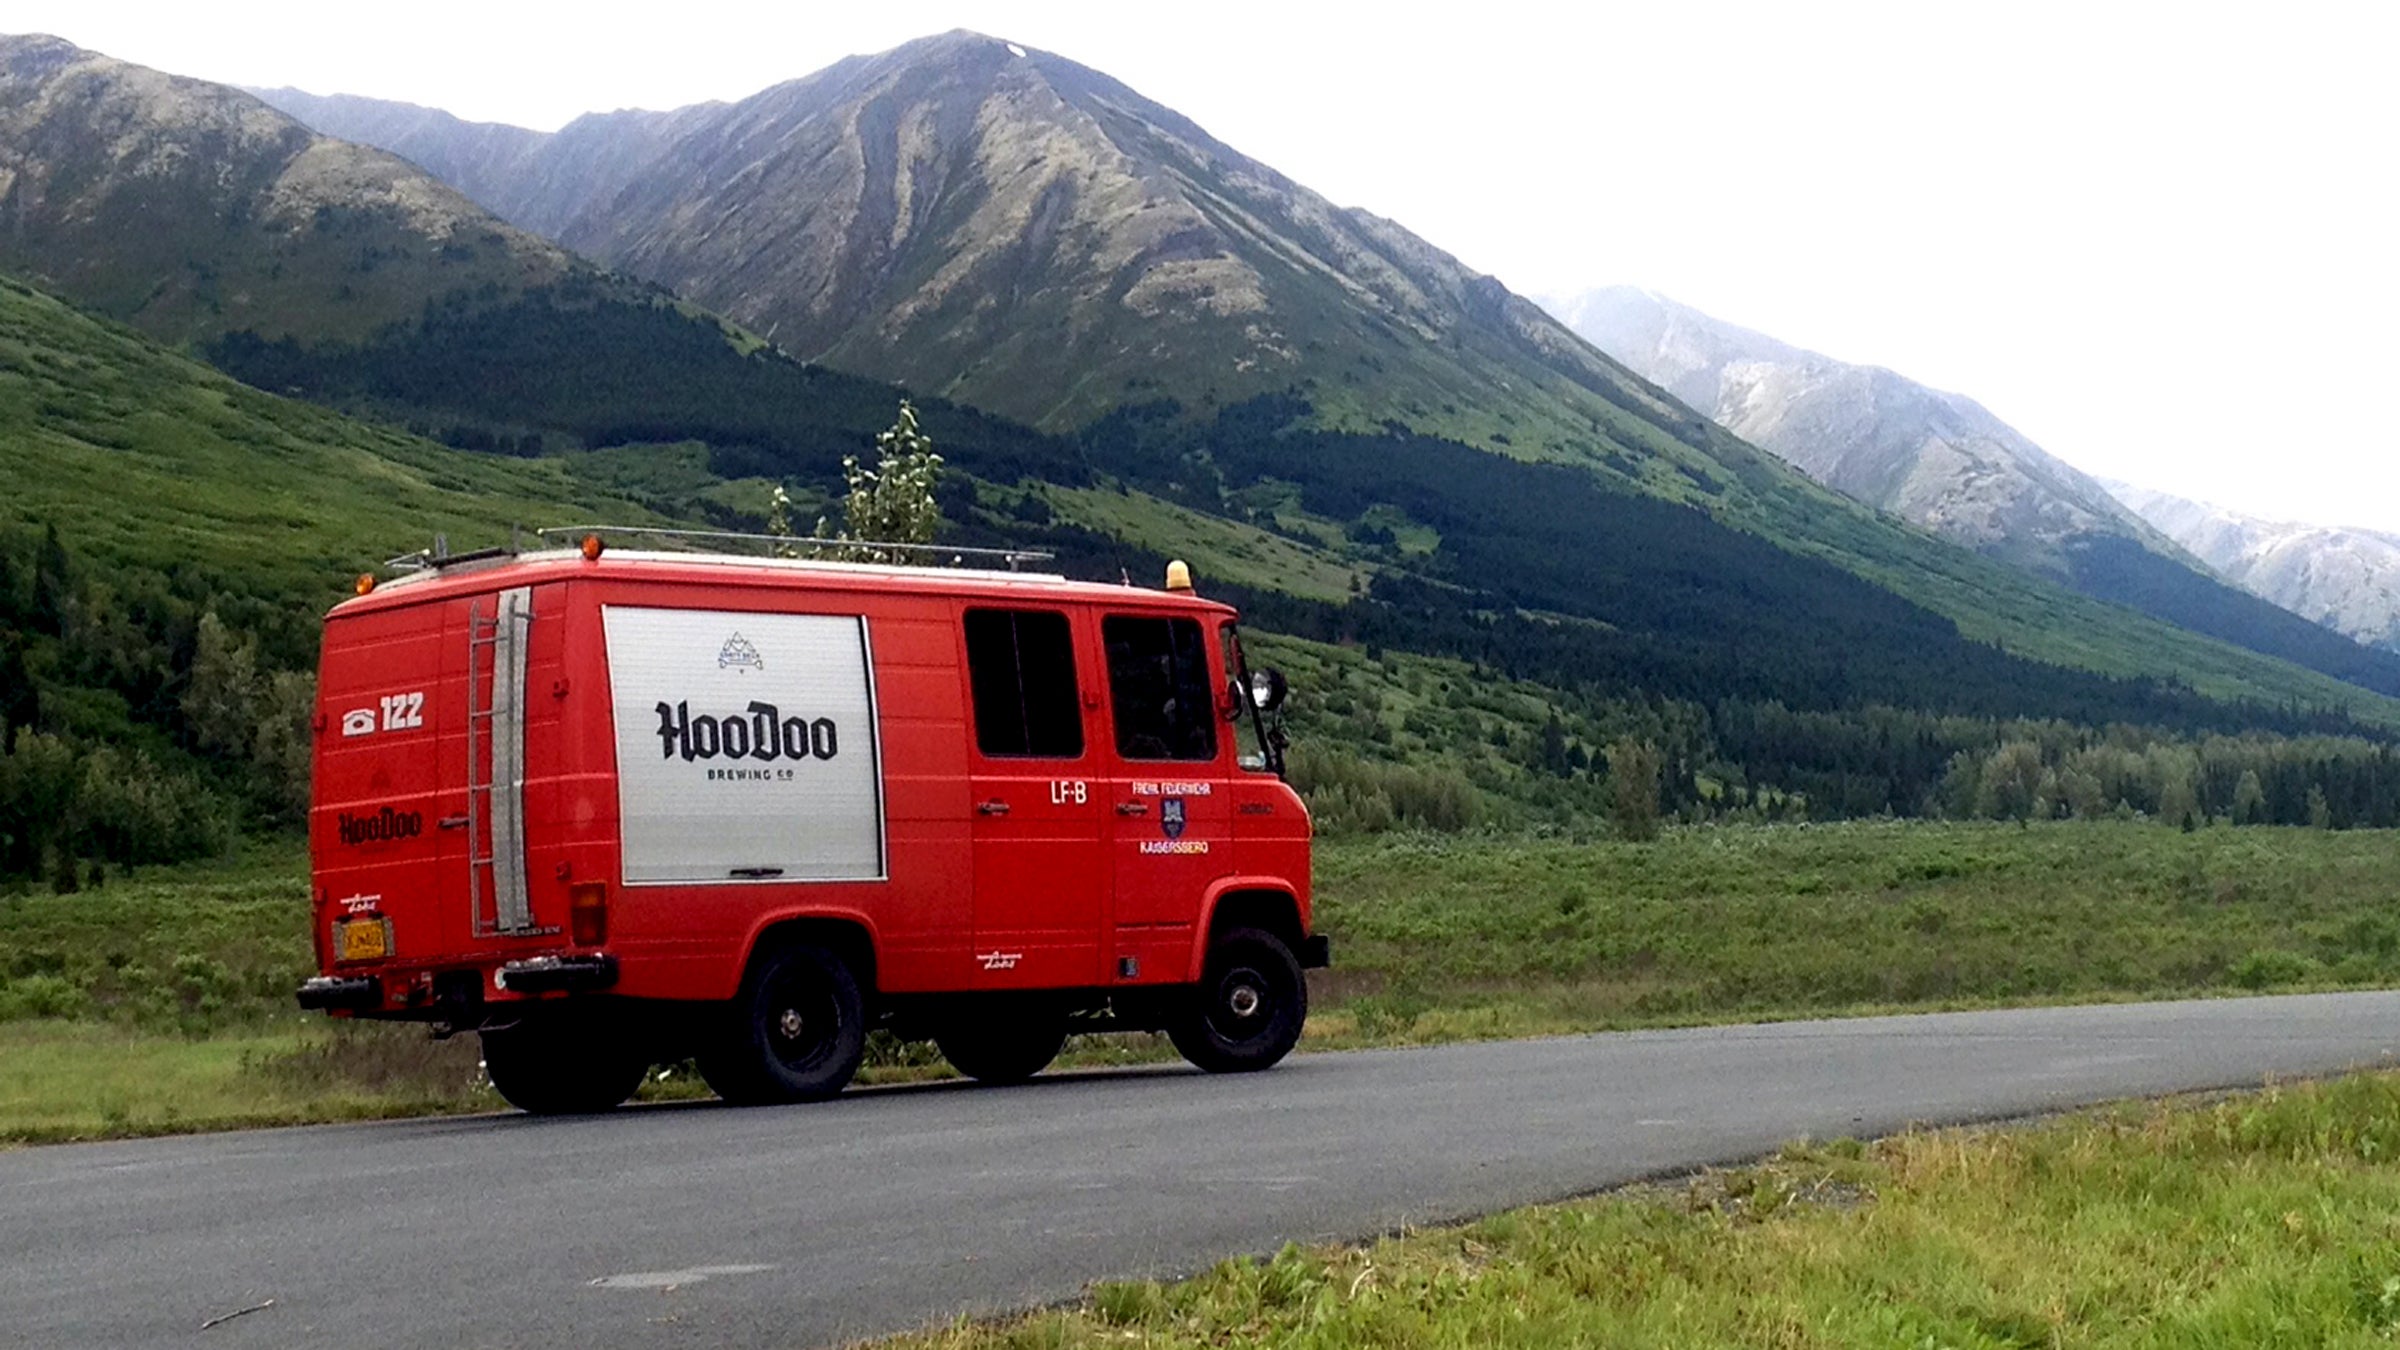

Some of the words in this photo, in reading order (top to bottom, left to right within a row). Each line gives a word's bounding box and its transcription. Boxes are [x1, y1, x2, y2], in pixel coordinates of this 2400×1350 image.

[380, 692, 423, 731] 122
[707, 769, 771, 780] BREWING
[777, 769, 794, 781] CO
